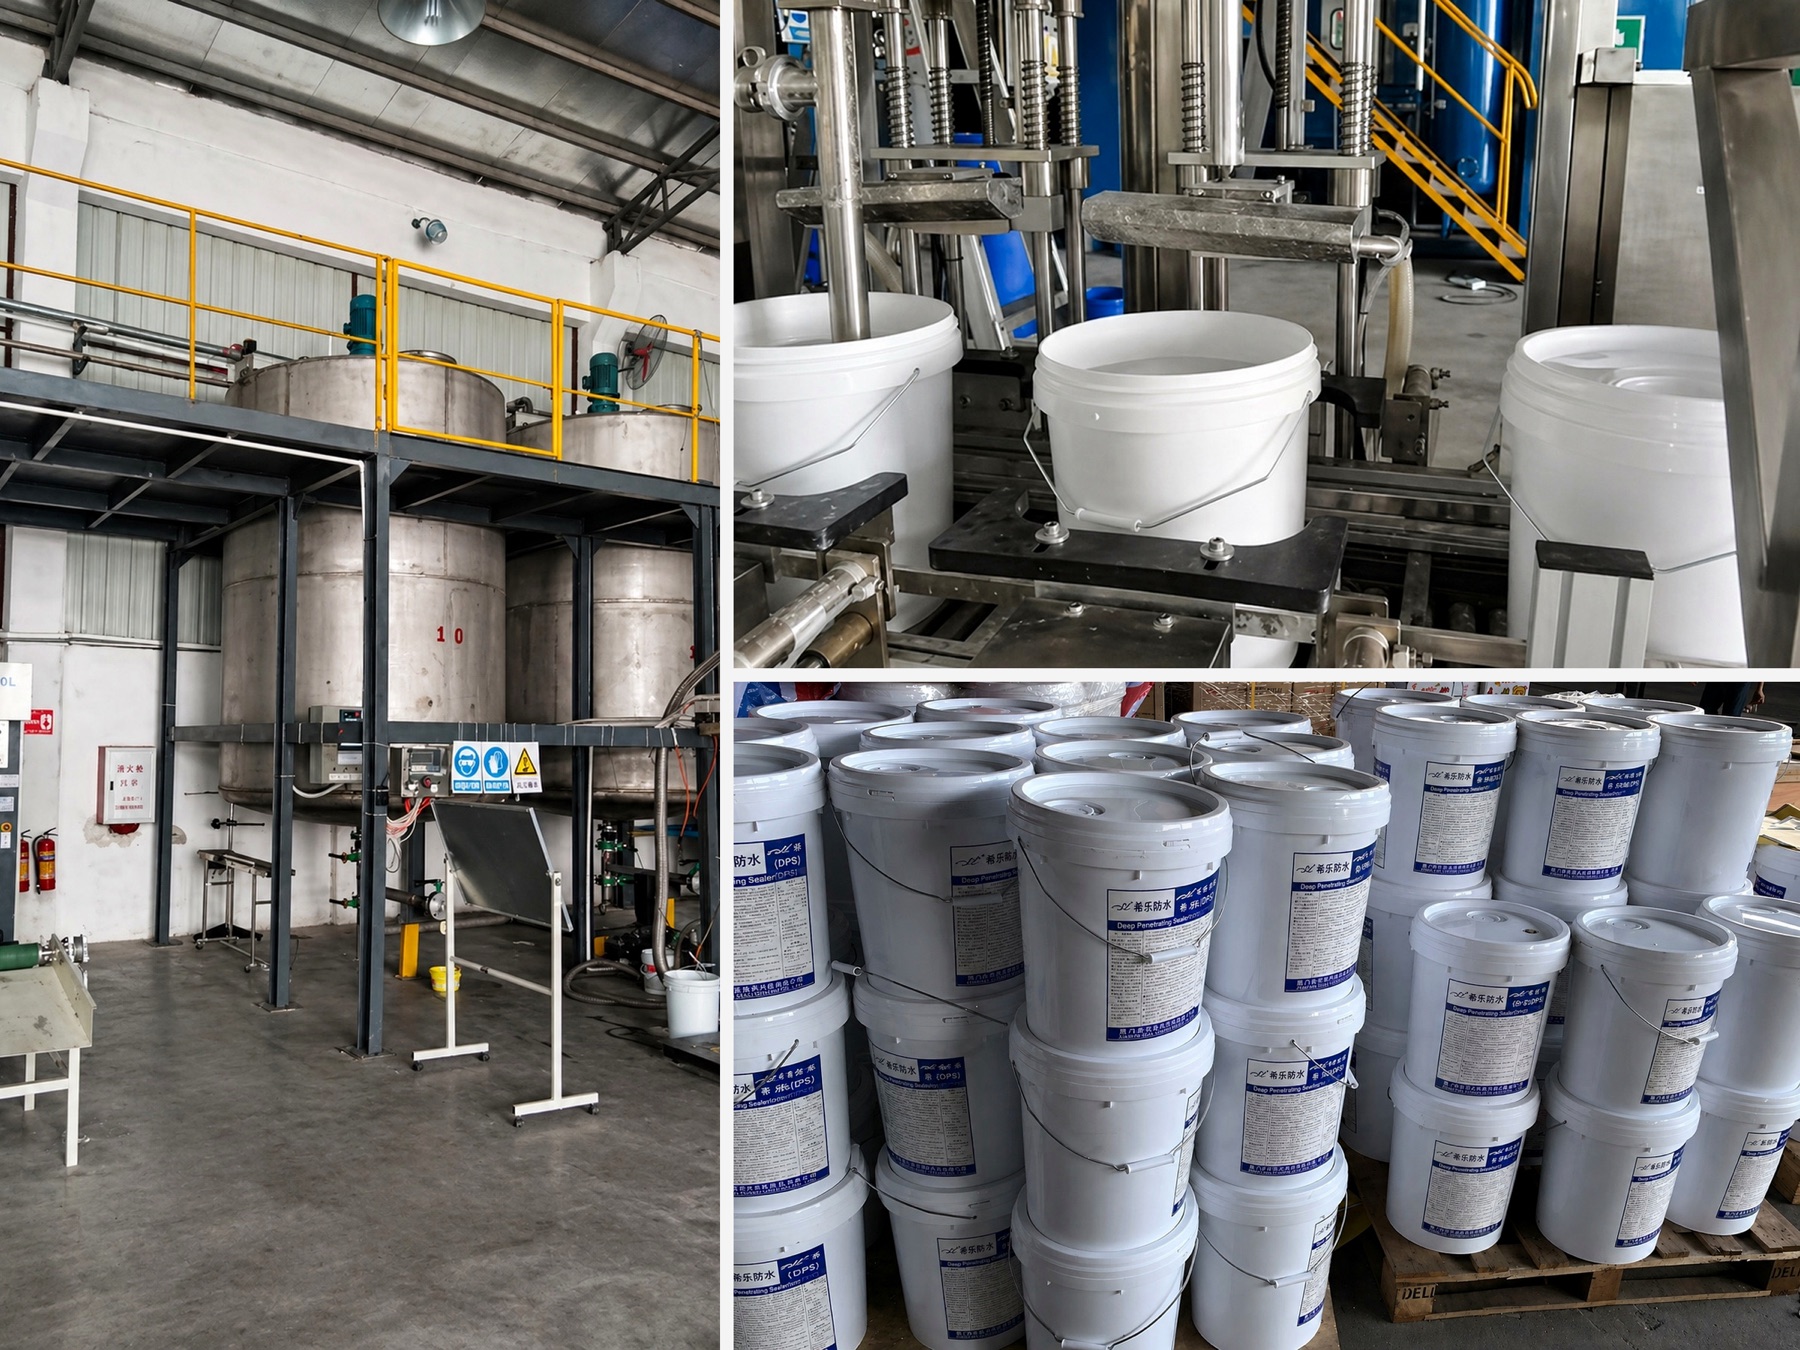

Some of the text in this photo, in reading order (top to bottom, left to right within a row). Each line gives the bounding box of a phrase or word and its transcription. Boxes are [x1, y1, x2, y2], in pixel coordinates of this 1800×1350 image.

[774, 855, 801, 870] (DPS)
[1316, 861, 1350, 875] 希乐防水
[1133, 900, 1172, 913] 希乐防水
[1117, 921, 1136, 930] Deep
[1136, 918, 1172, 929] Penetrating
[1468, 993, 1504, 1004] 希乐防水
[1269, 1070, 1305, 1081] 希乐防水
[788, 1262, 820, 1280] (DPS)
